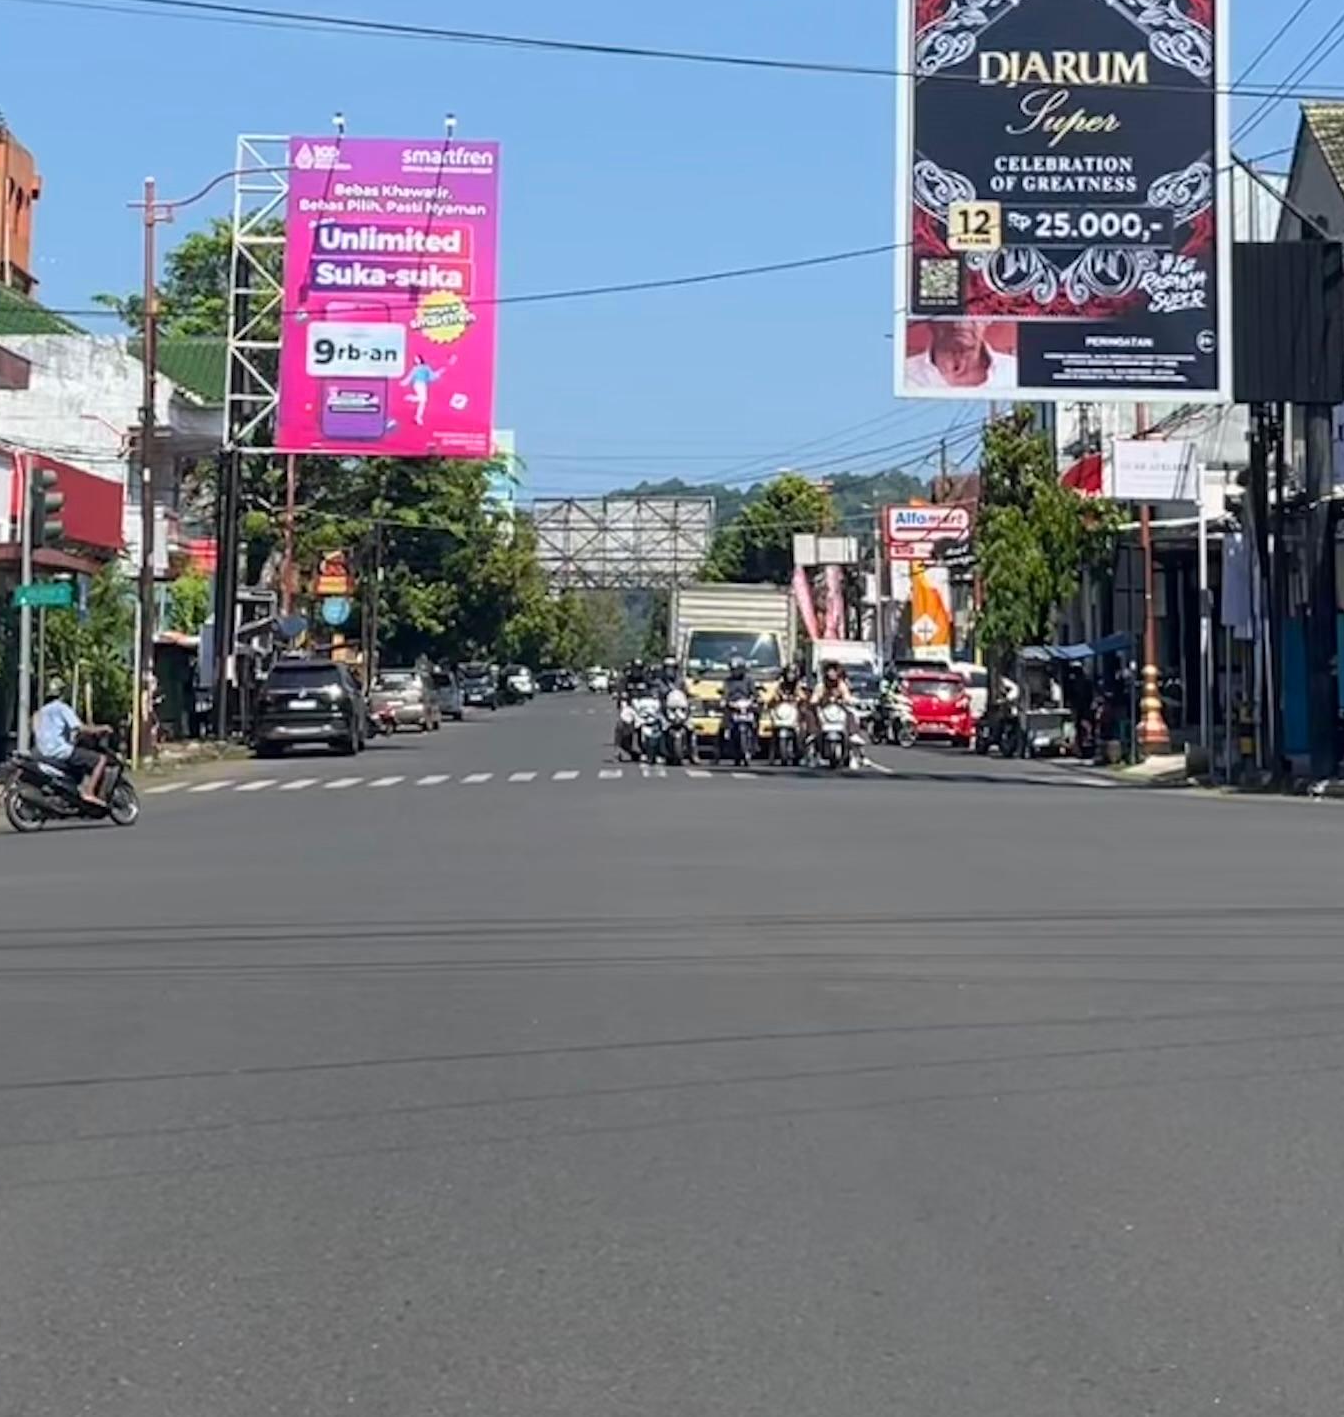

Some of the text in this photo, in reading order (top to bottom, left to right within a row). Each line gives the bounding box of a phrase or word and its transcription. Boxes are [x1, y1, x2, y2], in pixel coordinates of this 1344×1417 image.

[979, 50, 1148, 88] DJARUM
[1006, 88, 1120, 146] Super
[401, 146, 493, 166] smartfren
[994, 156, 1132, 172] CELEBRATION
[334, 184, 379, 197] Bebas
[990, 176, 1136, 193] OF GREATNESS
[299, 199, 344, 212] Bebas
[386, 201, 423, 214] Pasti
[426, 204, 486, 217] Nyaman
[958, 210, 990, 234] 12
[1008, 212, 1164, 242] Rp 25.000,-
[319, 226, 461, 254] Unlimited
[316, 262, 463, 289] Suka-suka
[314, 339, 397, 364] 9rb-an
